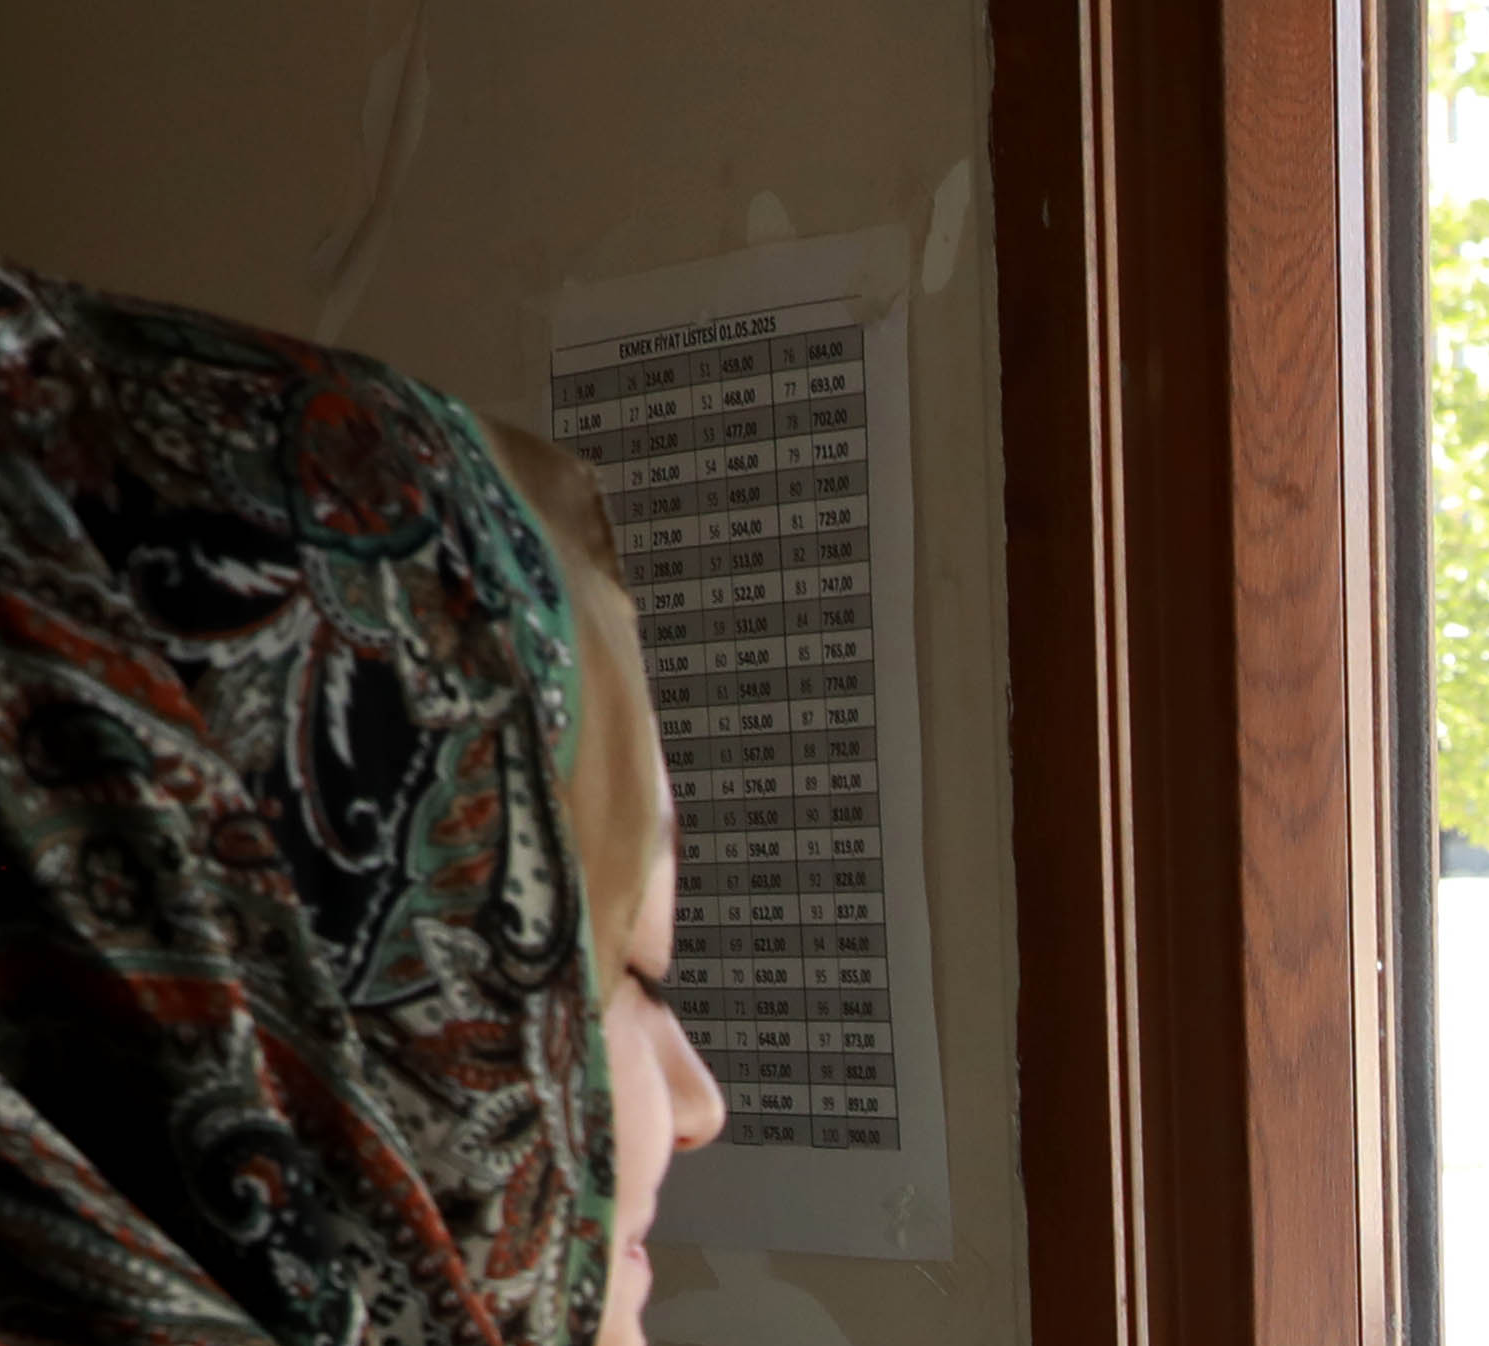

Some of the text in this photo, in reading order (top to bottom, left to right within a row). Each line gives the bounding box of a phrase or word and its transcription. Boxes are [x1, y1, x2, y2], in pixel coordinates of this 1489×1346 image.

[619, 316, 776, 359] EKMEK FİYAT LİSTESİ 01.05.2025
[724, 388, 755, 410] 468,00
[811, 374, 845, 397] 693,00
[728, 454, 759, 475] 486,00
[815, 441, 848, 463] 711,00
[731, 519, 762, 539] 504,00
[819, 508, 850, 529] 729,00
[734, 584, 765, 603] 522,00
[821, 575, 853, 595] 747,00
[738, 649, 769, 668] 540,00
[825, 641, 856, 660] 765,00
[741, 713, 773, 732] 558,00
[828, 707, 858, 726] 783,00
[671, 782, 696, 799] 51,00
[745, 778, 776, 795] 576,00
[832, 773, 861, 791] 801,00
[749, 842, 780, 859] 594,00
[834, 839, 865, 856] 819,00
[752, 906, 784, 923] 612,00
[837, 905, 868, 921] 837,00
[755, 969, 787, 985] 630,00
[840, 969, 872, 985] 855,00
[687, 1031, 711, 1046] 23,00
[759, 1032, 790, 1048] 648,00
[844, 1033, 875, 1049] 873,00
[762, 1095, 793, 1112] 666,00
[847, 1098, 878, 1114] 891,00
